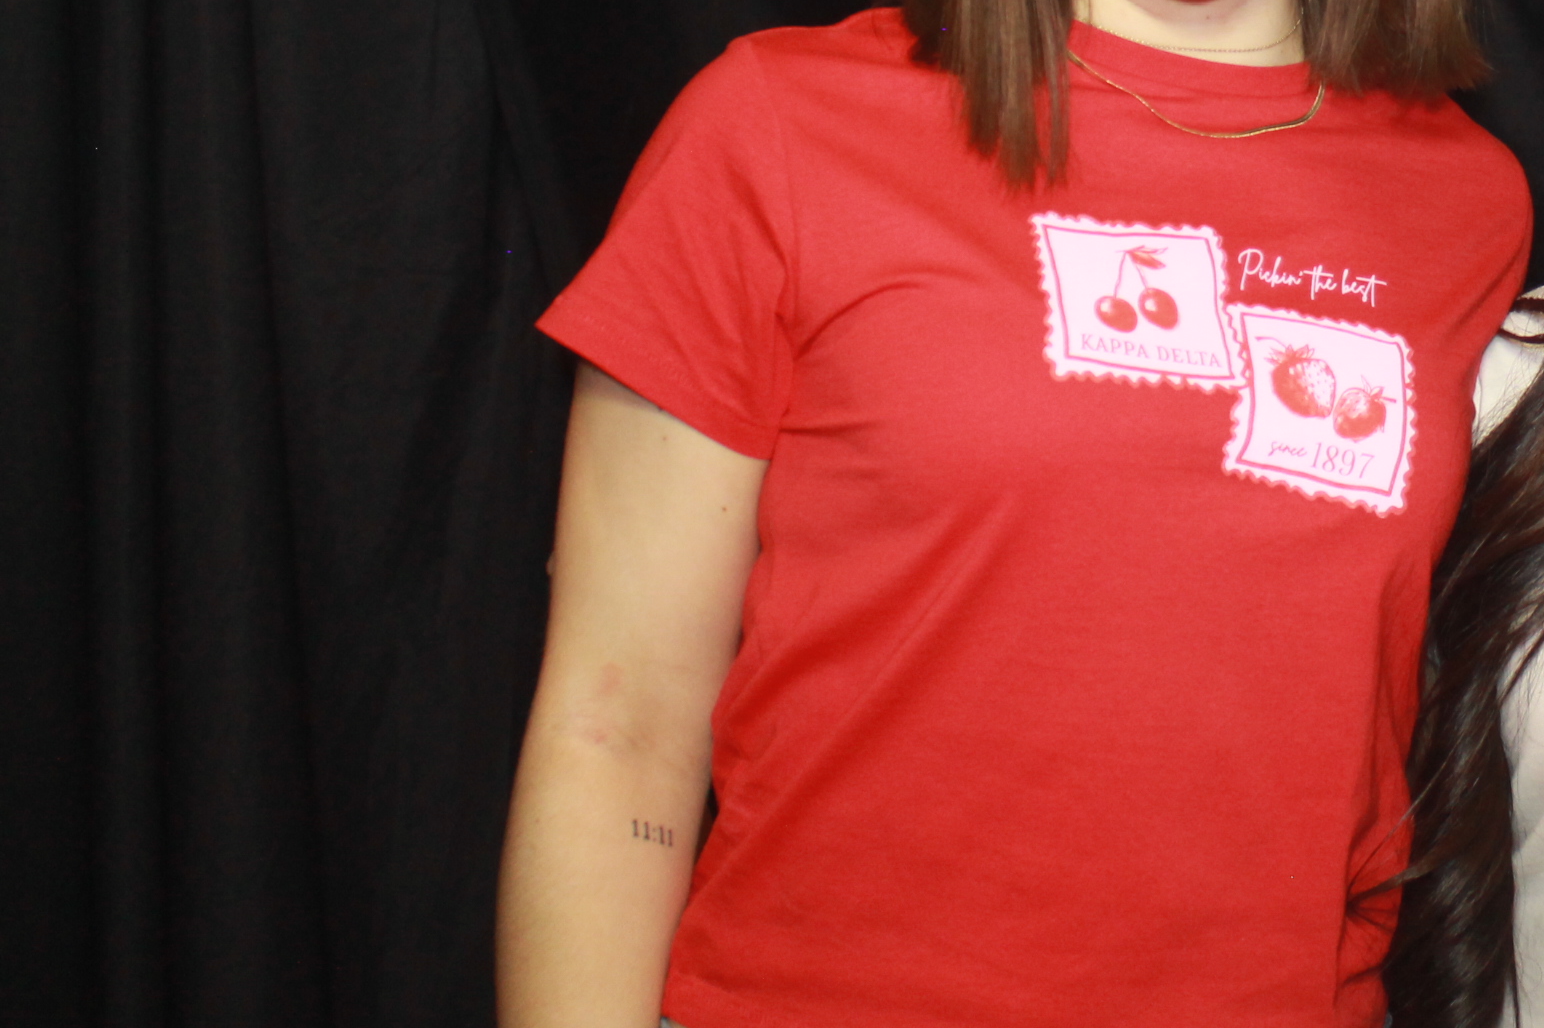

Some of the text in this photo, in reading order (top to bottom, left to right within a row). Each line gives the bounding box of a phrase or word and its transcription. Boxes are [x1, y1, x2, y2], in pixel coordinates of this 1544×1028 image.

[1304, 265, 1338, 300] the
[1341, 269, 1387, 307] best
[1080, 333, 1223, 369] KAPPA DELTA
[1268, 440, 1375, 480] since 1897
[631, 818, 674, 848] 11:11
